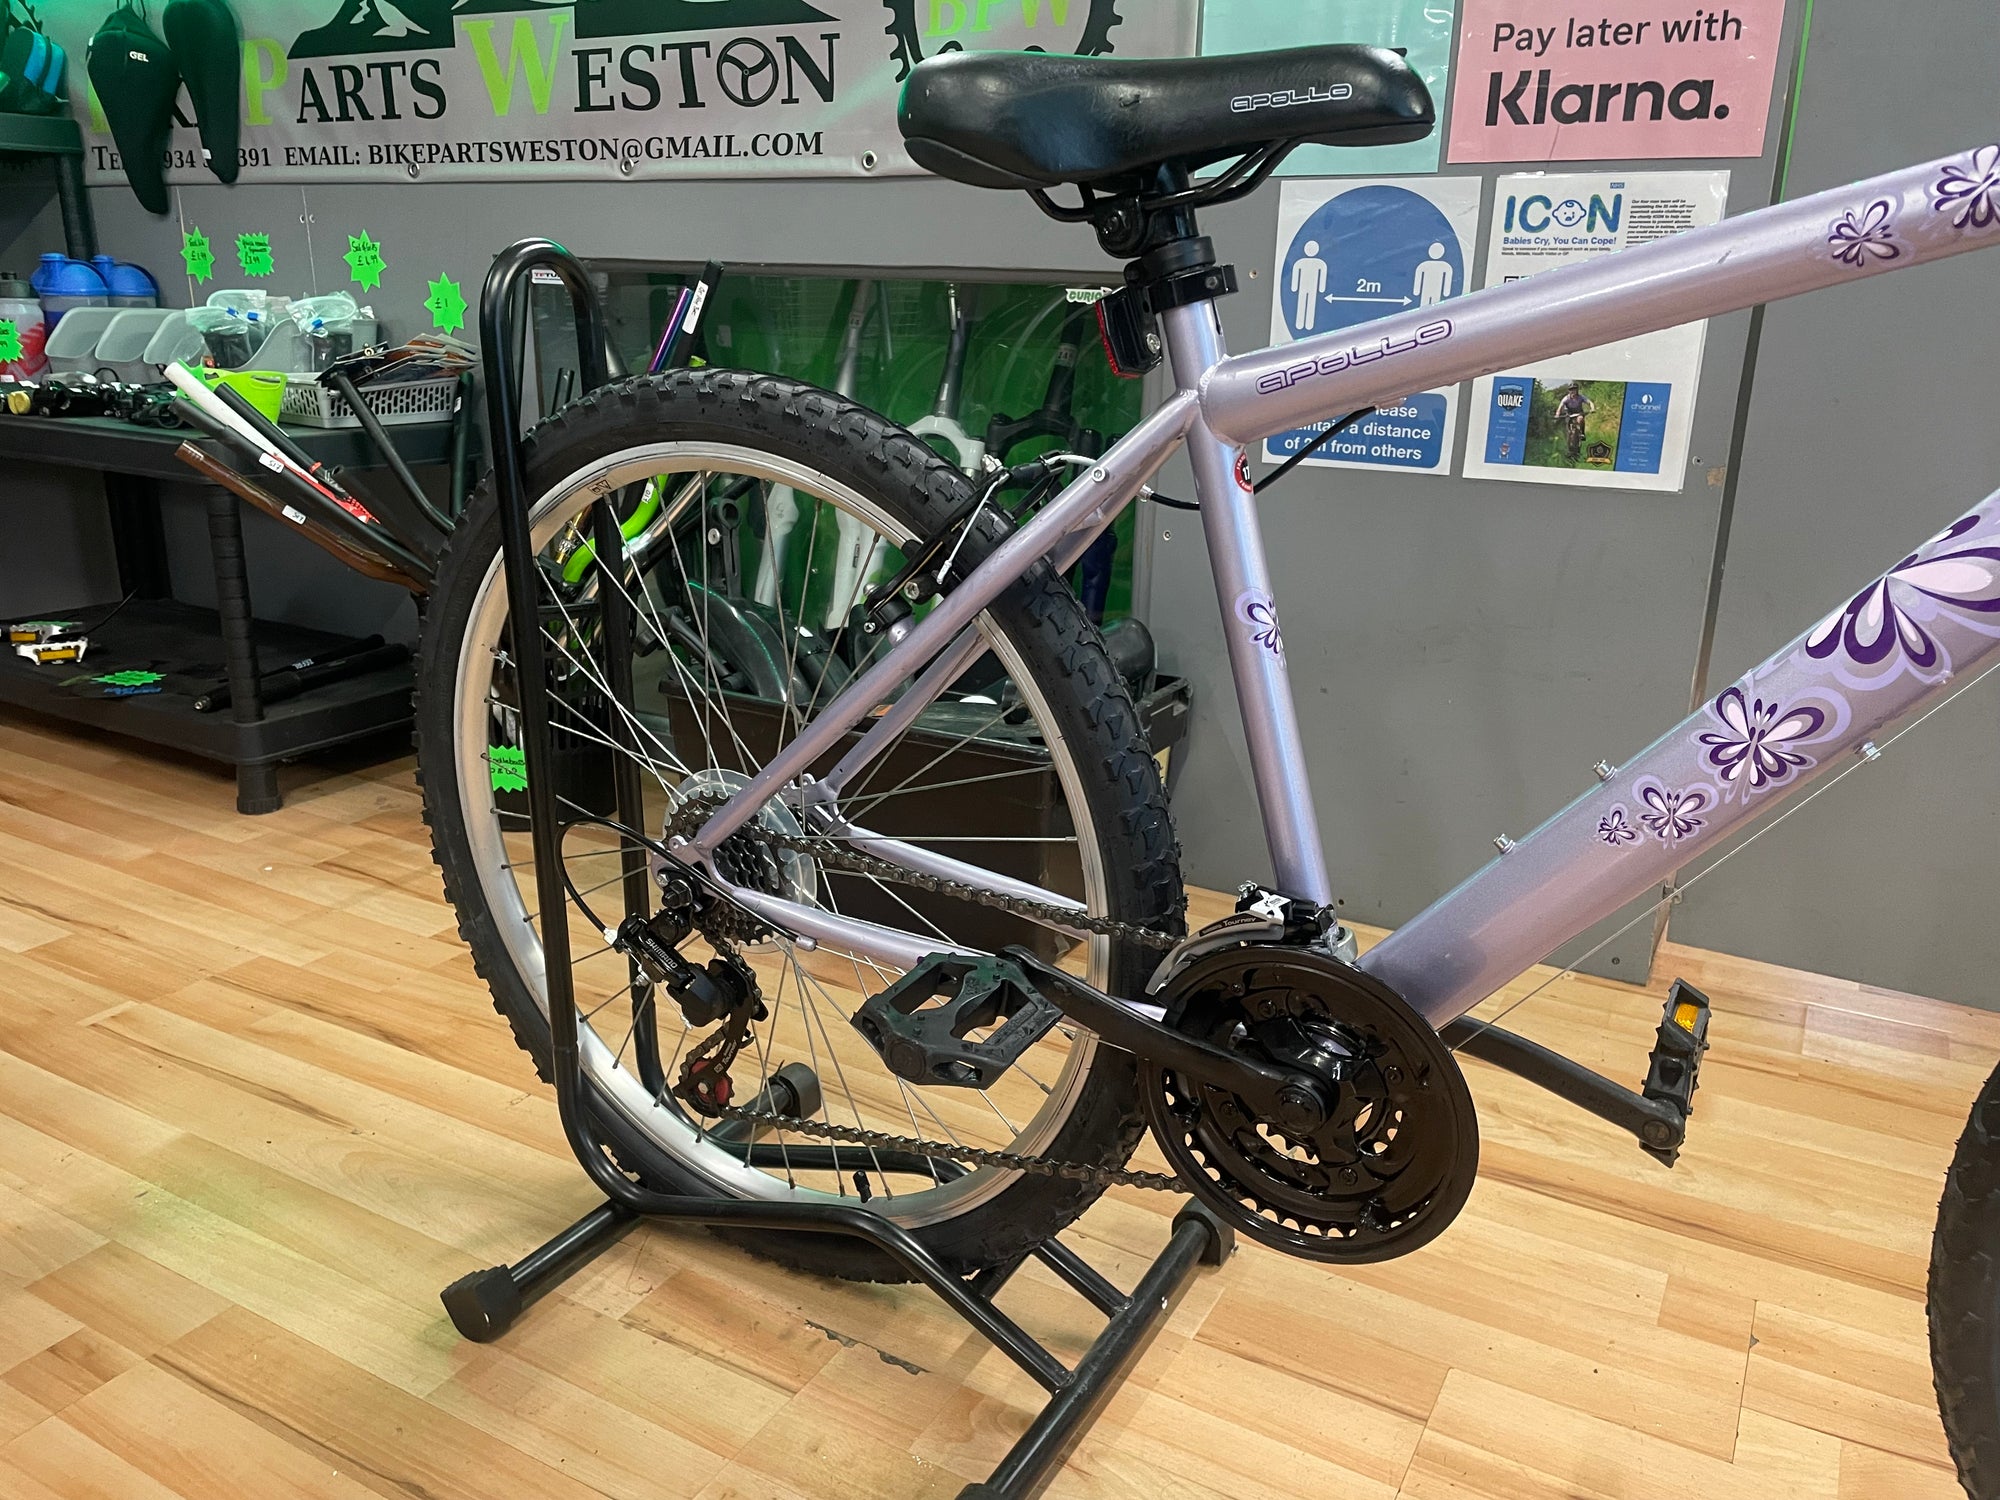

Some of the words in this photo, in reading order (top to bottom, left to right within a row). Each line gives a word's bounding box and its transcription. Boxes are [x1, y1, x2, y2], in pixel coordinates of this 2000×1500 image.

[1493, 23, 1556, 57] Pay
[1566, 18, 1651, 48] later
[1662, 9, 1742, 43] with
[129, 50, 149, 62] GEL
[240, 38, 447, 126] PARTS
[461, 13, 840, 116] WESTON
[1485, 69, 1730, 126] Klarna.
[163, 149, 196, 169] 934
[285, 146, 360, 167] EMAIL:
[369, 131, 823, 166] BIKEPARTSWESTON@GMAIL.COM
[1503, 237, 1531, 245] Babies
[1534, 237, 1550, 246] Cry,
[1553, 237, 1569, 245] You
[1571, 237, 1588, 245] Can
[1591, 237, 1617, 246] Cope!
[1356, 279, 1382, 293] 2m
[1497, 394, 1523, 407] QUAKE
[1375, 404, 1418, 418] lease
[1349, 424, 1359, 434] a
[1363, 423, 1431, 440] distance
[1284, 437, 1301, 450] of
[1331, 440, 1366, 456] from
[1371, 445, 1422, 460] others
[645, 937, 678, 969] SHIMANO
